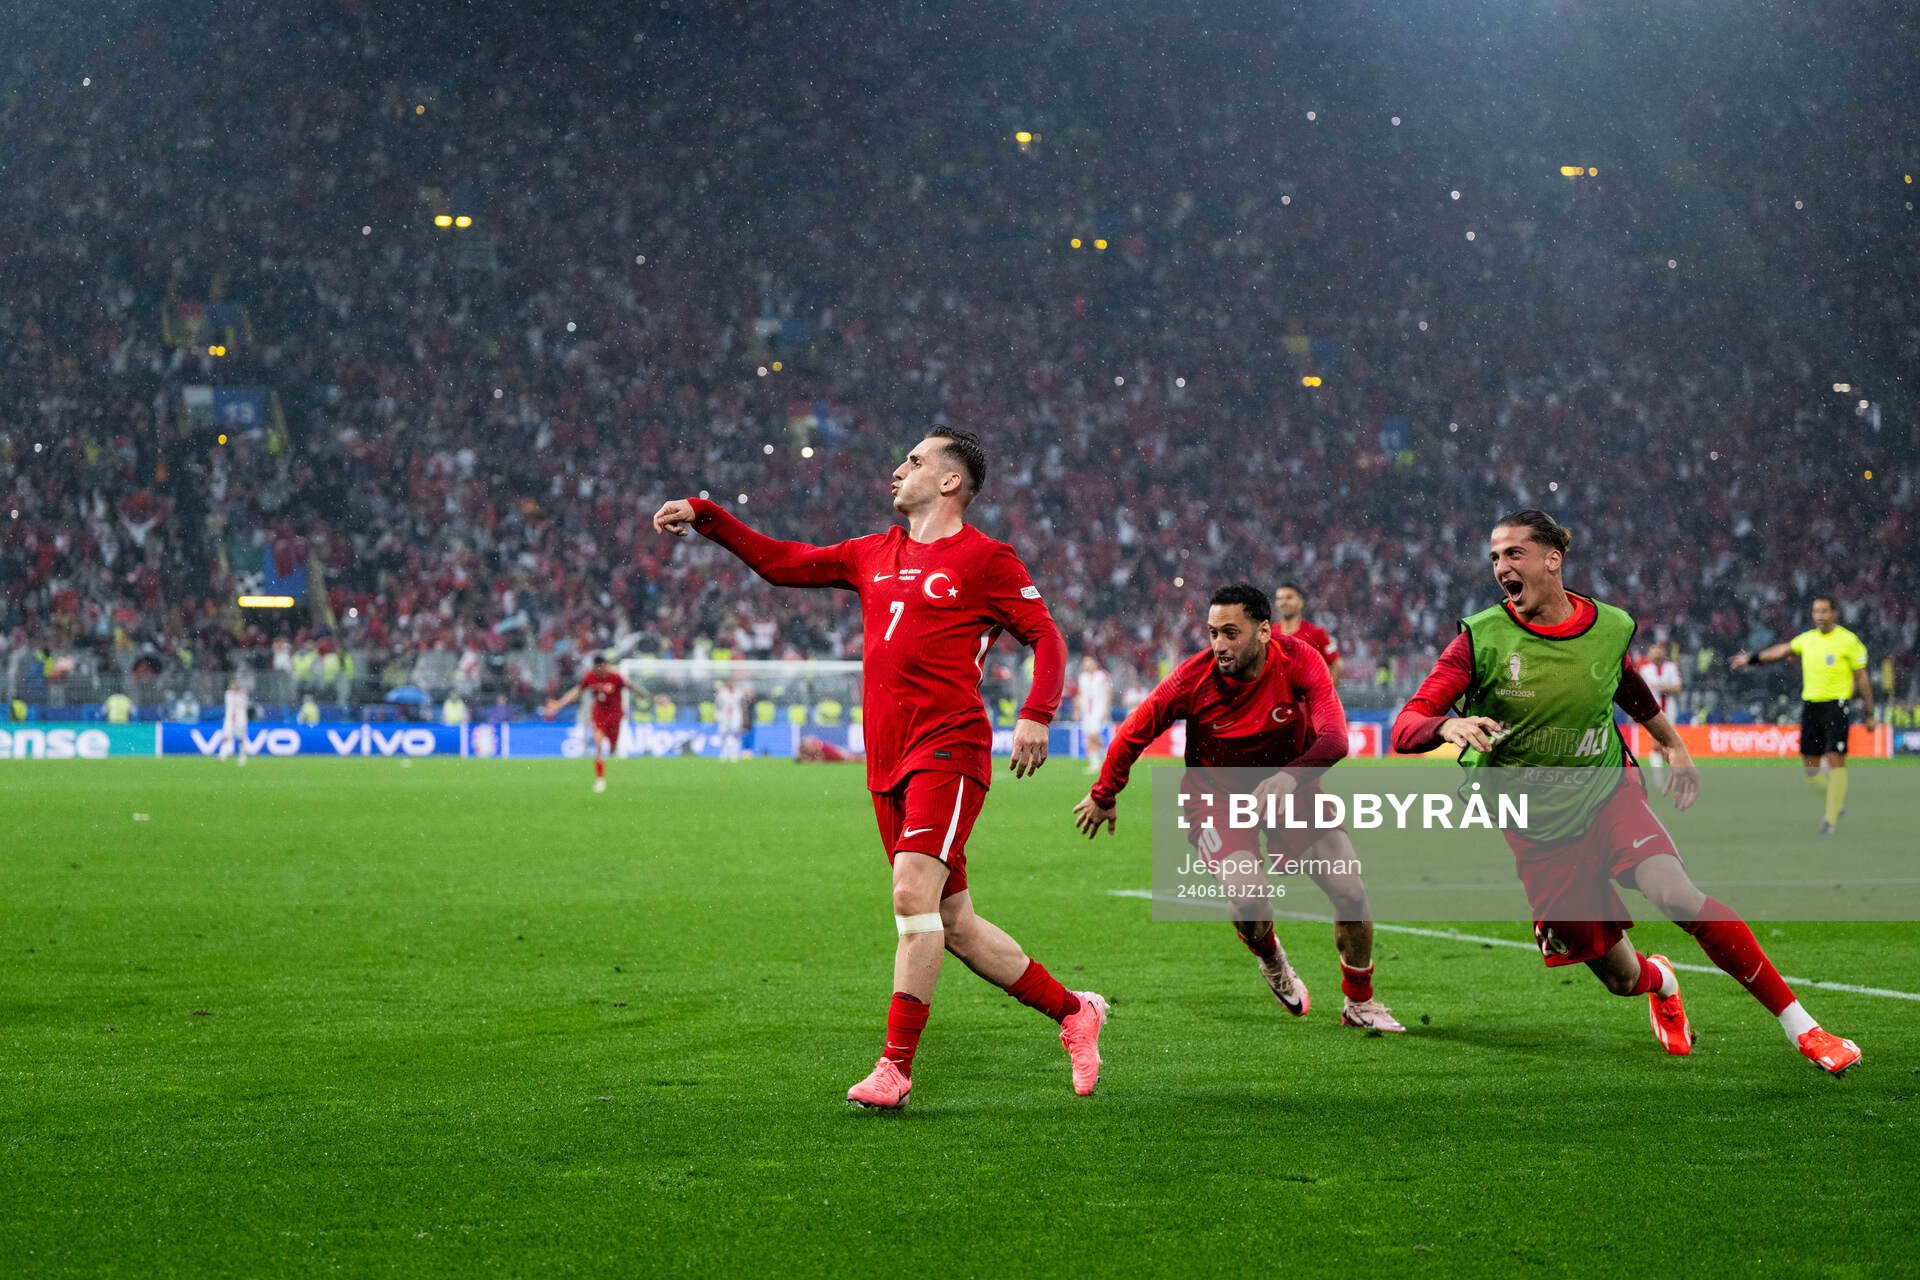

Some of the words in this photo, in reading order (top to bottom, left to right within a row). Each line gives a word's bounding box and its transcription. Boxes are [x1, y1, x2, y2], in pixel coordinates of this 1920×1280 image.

[884, 601, 904, 641] 7
[190, 728, 300, 755] vvo
[327, 723, 436, 756] vivo
